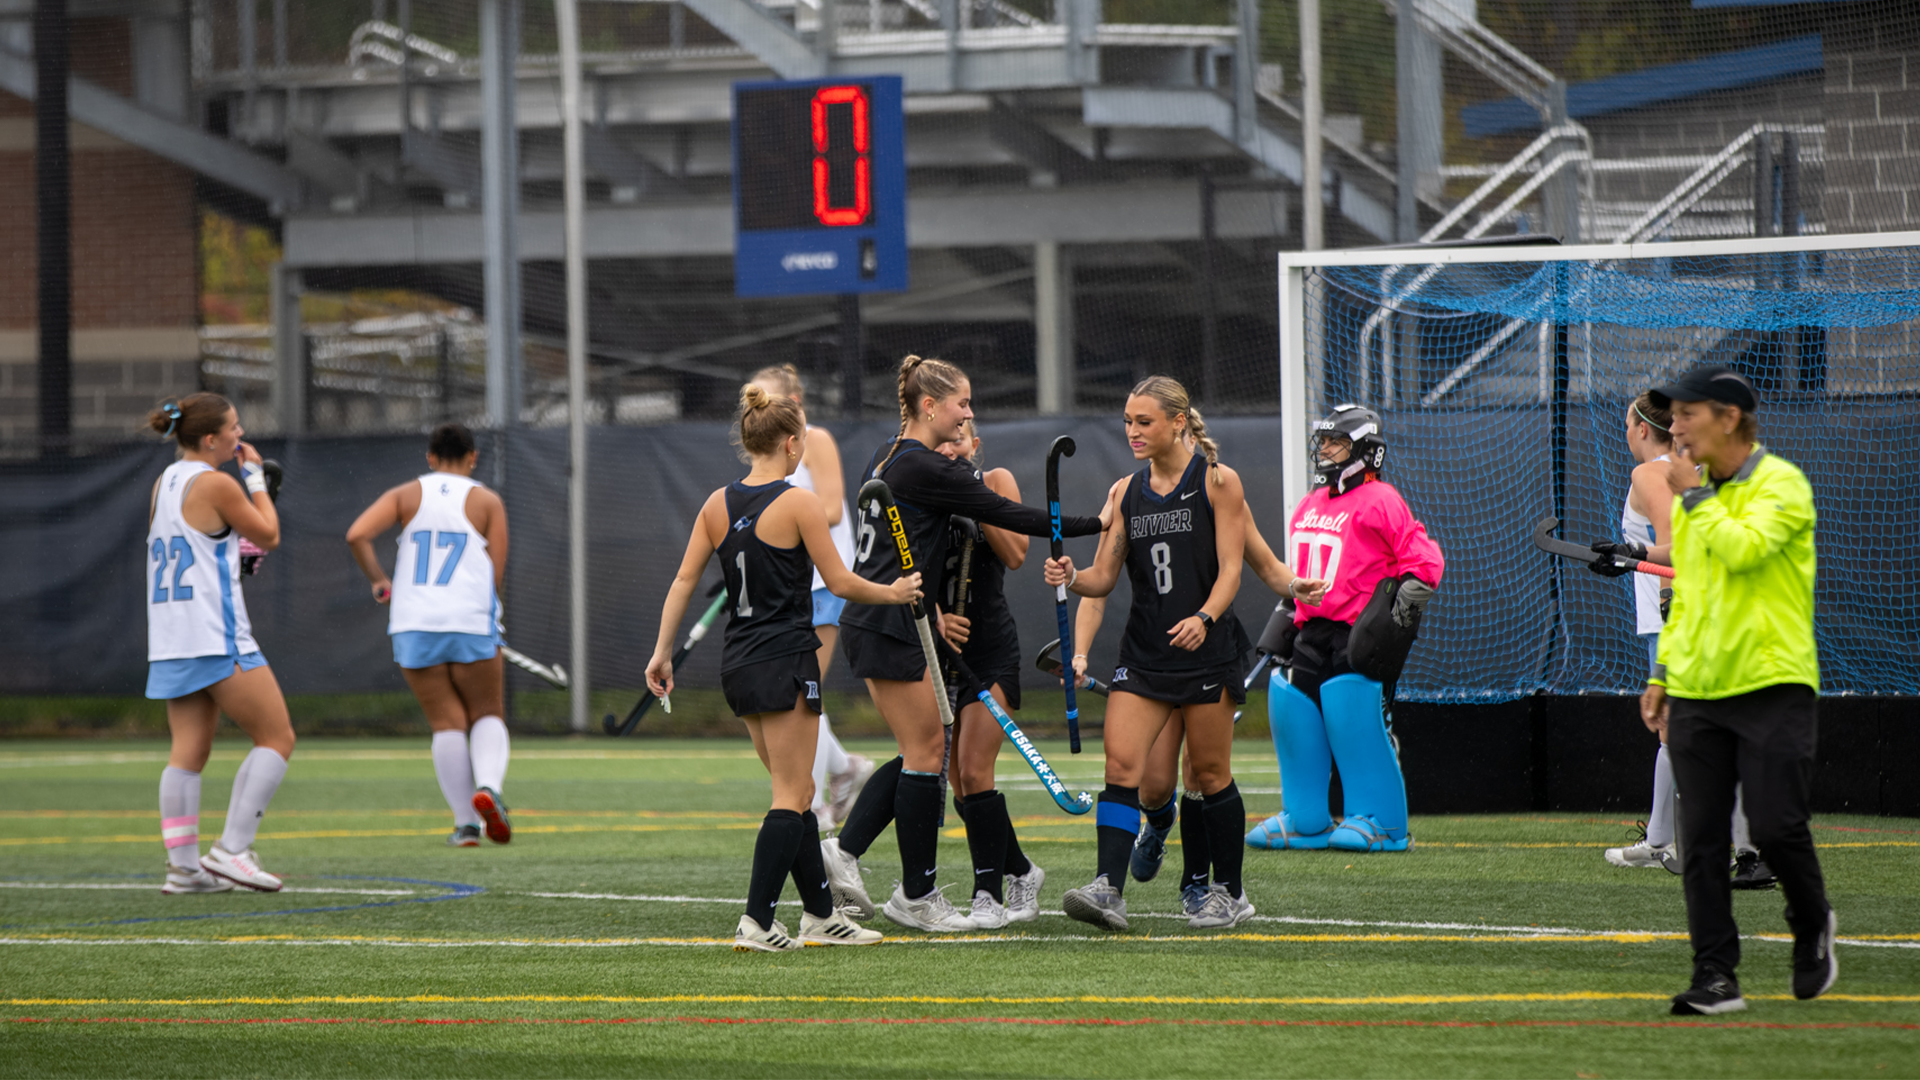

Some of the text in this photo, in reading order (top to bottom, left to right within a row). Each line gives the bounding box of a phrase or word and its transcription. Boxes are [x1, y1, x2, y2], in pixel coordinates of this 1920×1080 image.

[811, 85, 871, 226] 0
[886, 505, 914, 570] brabo
[1050, 501, 1063, 543] STX
[1130, 509, 1192, 539] RIVIER
[1295, 508, 1348, 532] Lasell
[152, 536, 194, 604] 22
[411, 530, 468, 586] 17
[736, 551, 753, 617] 1
[1151, 542, 1173, 594] 8
[1291, 532, 1342, 593] 00
[805, 681, 819, 699] R
[1011, 729, 1042, 765] OSAKA
